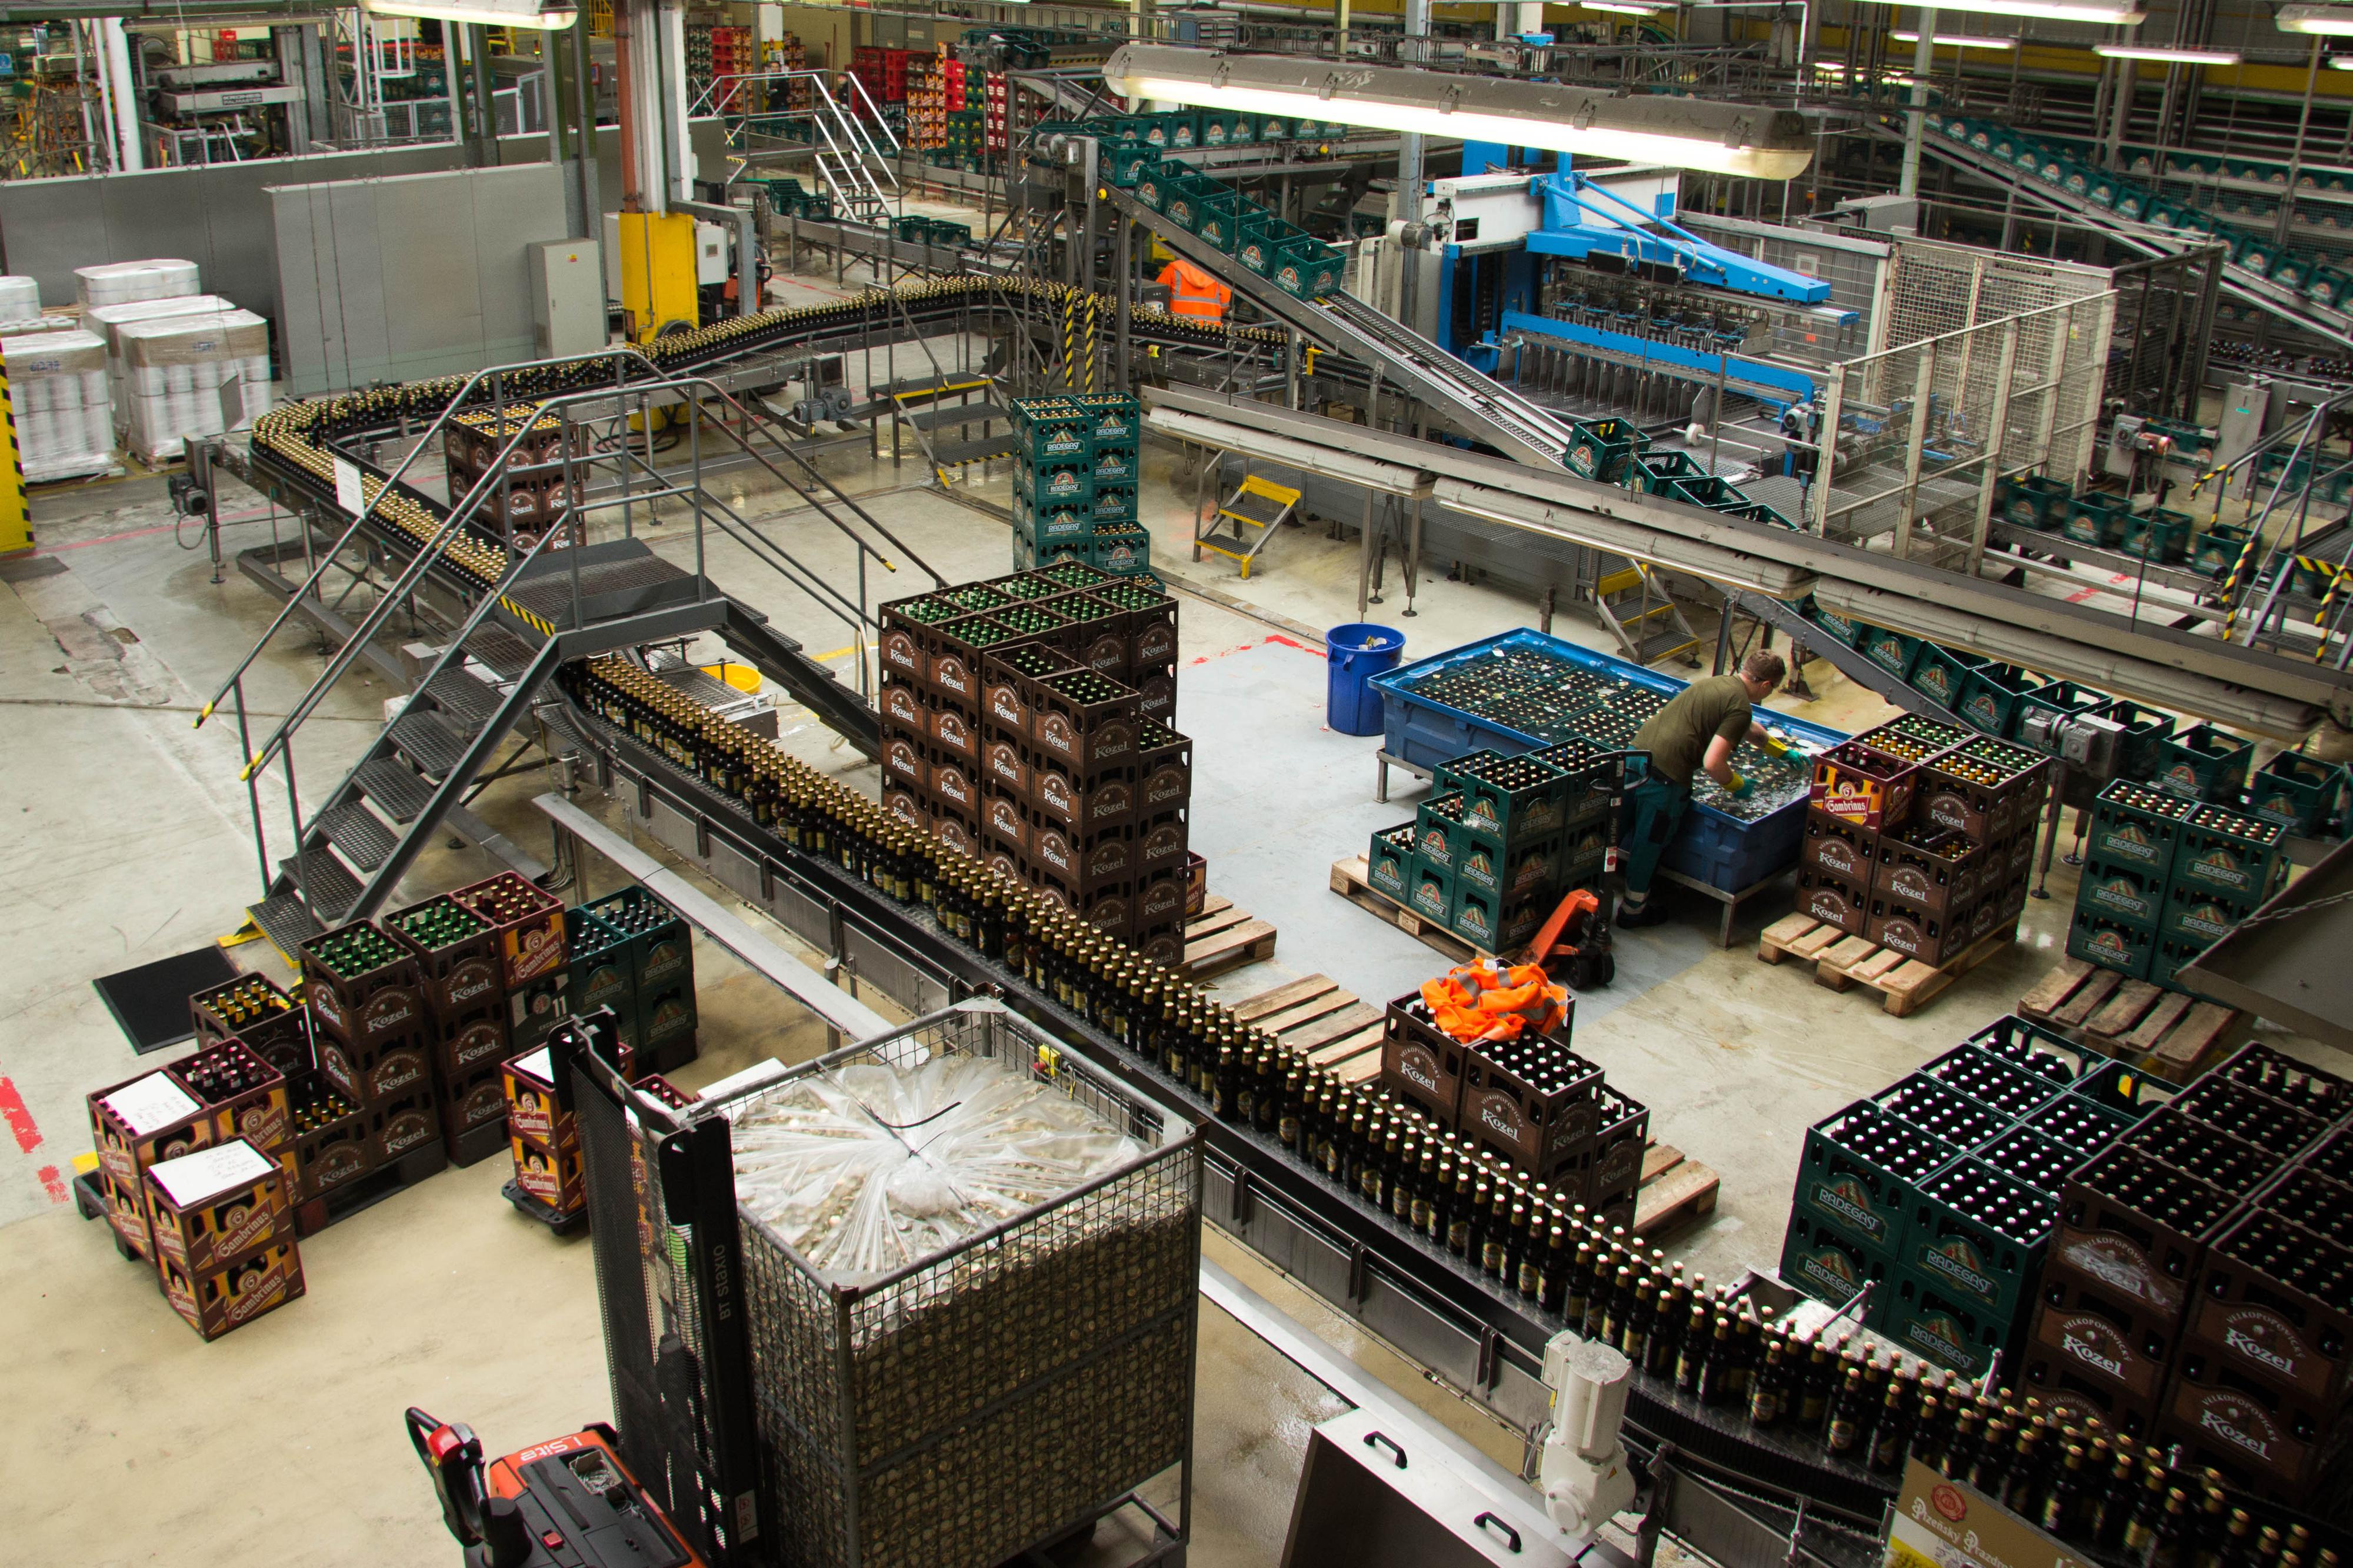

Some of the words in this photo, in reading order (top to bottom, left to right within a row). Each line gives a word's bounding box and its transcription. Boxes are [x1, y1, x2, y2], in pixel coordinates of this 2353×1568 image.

[1096, 426, 1128, 436] RADEGAST
[1047, 442, 1079, 451] RADEGAST
[1095, 466, 1126, 476] RADEGAST
[1570, 453, 1593, 472] RADEGAST
[1051, 484, 1079, 492] RADEGAST
[1095, 506, 1126, 515] RADEGAST
[1048, 523, 1080, 533] RADEGAST
[1108, 558, 1136, 567] RADEGAST
[890, 649, 914, 668] Kozel
[1092, 653, 1122, 670] Kozel
[1142, 642, 1171, 659] Kozel
[1874, 646, 1902, 669] RADEGAST
[940, 672, 966, 693] Kozel
[1919, 673, 1948, 697] RADEGAST
[891, 703, 915, 723] Kozel
[994, 702, 1019, 725] Kozel
[1141, 695, 1170, 712] Kozel
[941, 727, 966, 748] Kozel
[1045, 730, 1071, 753] Kozel
[1094, 741, 1131, 759] Kozel
[892, 755, 916, 776] Kozel
[994, 758, 1018, 782] Kozel
[941, 780, 966, 803] Kozel
[1044, 788, 1070, 812] Kozel
[1148, 785, 1182, 803] Kozel
[894, 806, 915, 825] Kozel
[1093, 800, 1129, 818] Kozel
[1826, 800, 1866, 813] Gambrinus
[994, 813, 1018, 838] Kozel
[1469, 810, 1499, 832] RADEGAST
[1931, 809, 1967, 830] Kozel
[942, 833, 966, 855] Kozel
[1146, 842, 1179, 860] Kozel
[1421, 842, 1450, 862] RADEGAST
[2107, 836, 2154, 858] RADEGAST
[1043, 845, 1069, 870] Kozel
[1091, 858, 1126, 876] Kozel
[1819, 852, 1853, 873] Kozel
[1374, 869, 1402, 890] RADEGAST
[1464, 865, 1495, 886] RADEGAST
[2194, 862, 2244, 883] RADEGAST
[1892, 880, 1928, 903] Kozel
[2097, 889, 2143, 910] RADEGAST
[1144, 898, 1178, 916] Kozel
[1416, 893, 1444, 913] RADEGAST
[1811, 902, 1845, 925] Kozel
[1091, 914, 1125, 930] Kozel
[1459, 916, 1490, 939] RADEGAST
[1883, 931, 1919, 954] Kozel
[2088, 943, 2128, 961] RADEGAST
[516, 940, 559, 979] Gambrinus
[450, 978, 493, 1004] Kozel
[552, 995, 568, 1017] 11
[367, 1006, 412, 1033] Kozel
[458, 1039, 500, 1065] Kozel
[376, 1067, 422, 1095] Kozel
[1401, 1060, 1439, 1094] Kozel
[466, 1098, 506, 1123] Kozel
[1481, 1108, 1521, 1143] Kozel
[386, 1127, 429, 1155] Kozel
[319, 1159, 364, 1187] Kozel
[1819, 1188, 1879, 1230] RADEGAST
[218, 1210, 269, 1257] Gambrinus
[713, 1245, 729, 1297] staxio
[1927, 1249, 1993, 1293] RADEGAST
[231, 1275, 281, 1321] Gambrinus
[719, 1302, 731, 1320] BT
[1910, 1324, 1974, 1369] RADEGAST
[2062, 1333, 2126, 1380] Kozel
[2224, 1326, 2298, 1379] Kozel
[2200, 1409, 2272, 1461] Kozel
